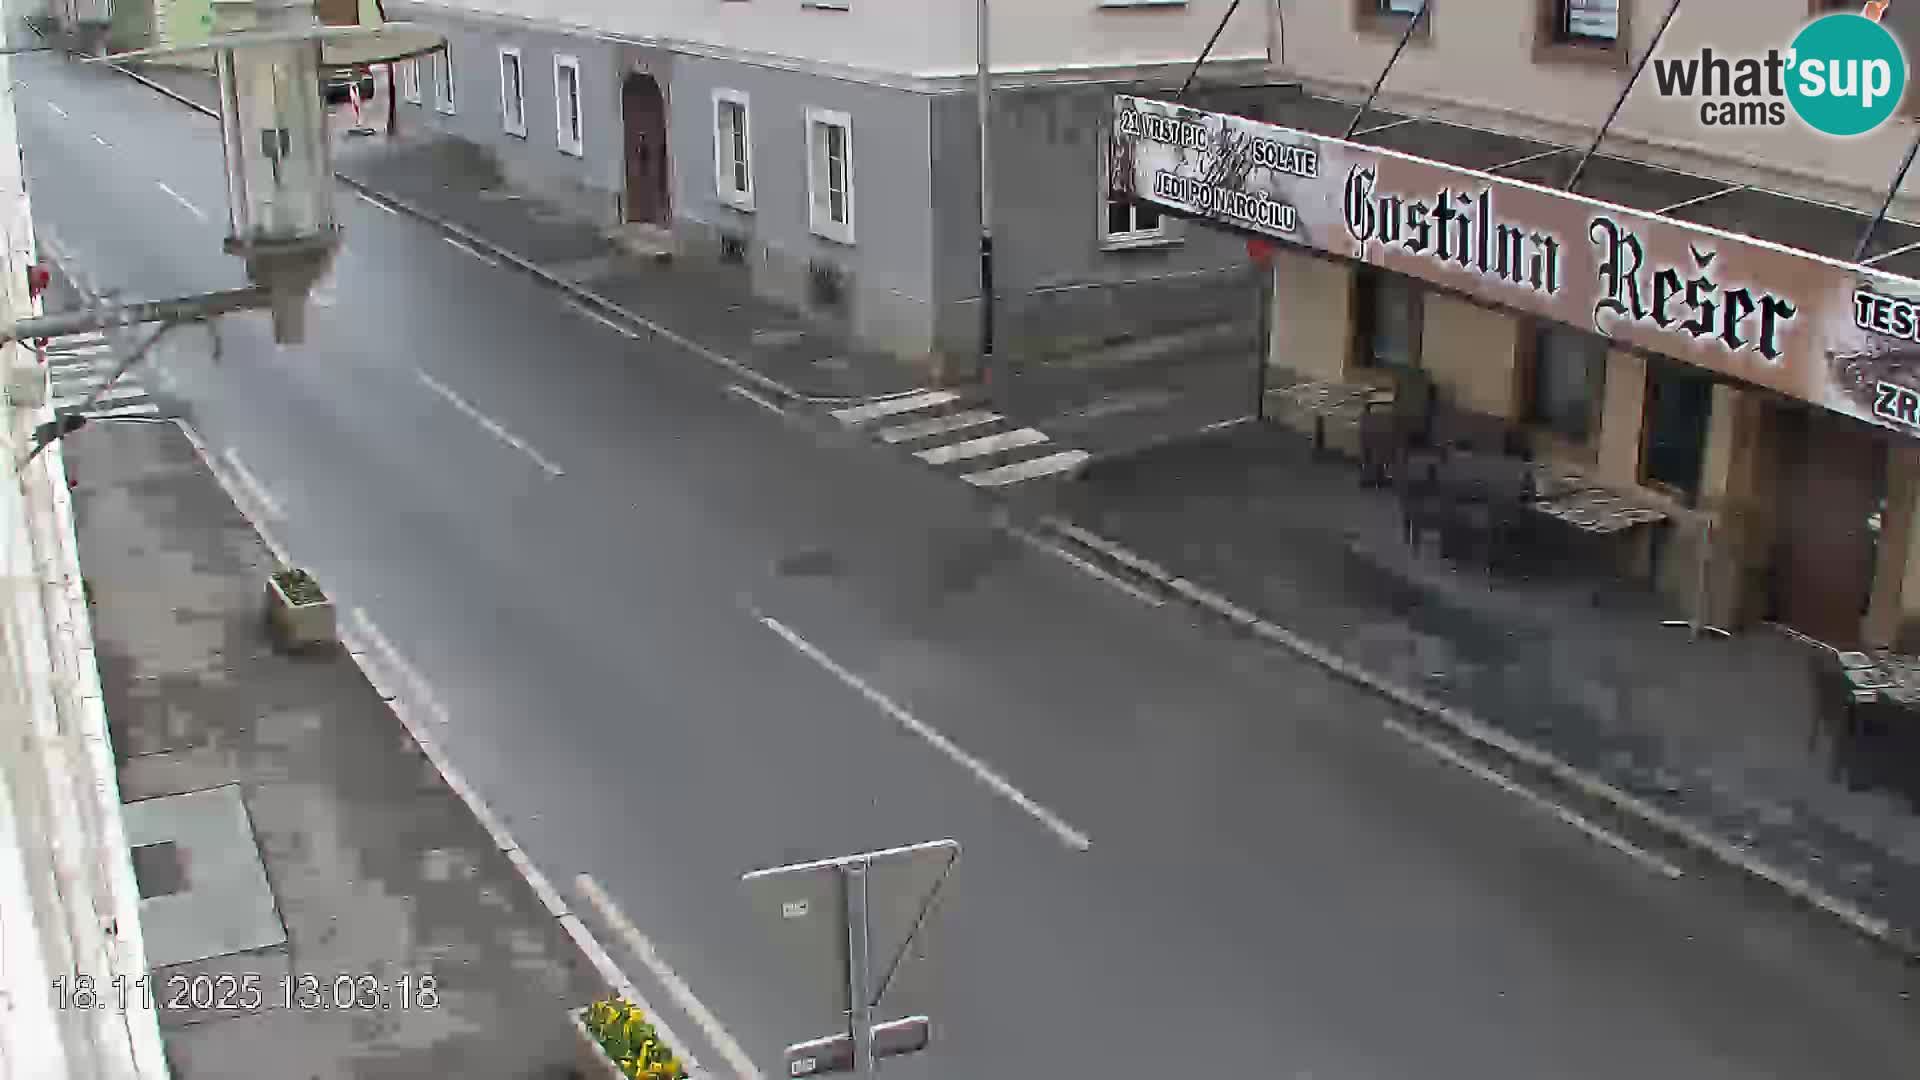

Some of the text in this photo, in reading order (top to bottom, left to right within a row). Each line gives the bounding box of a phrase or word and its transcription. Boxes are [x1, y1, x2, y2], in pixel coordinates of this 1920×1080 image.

[1141, 112, 1180, 144] VRST
[1252, 137, 1318, 178] SOLATE
[1154, 170, 1297, 232] JEDI PO NAROČILU
[1344, 163, 1561, 295] Gostilna
[1590, 216, 1798, 362] Rešer
